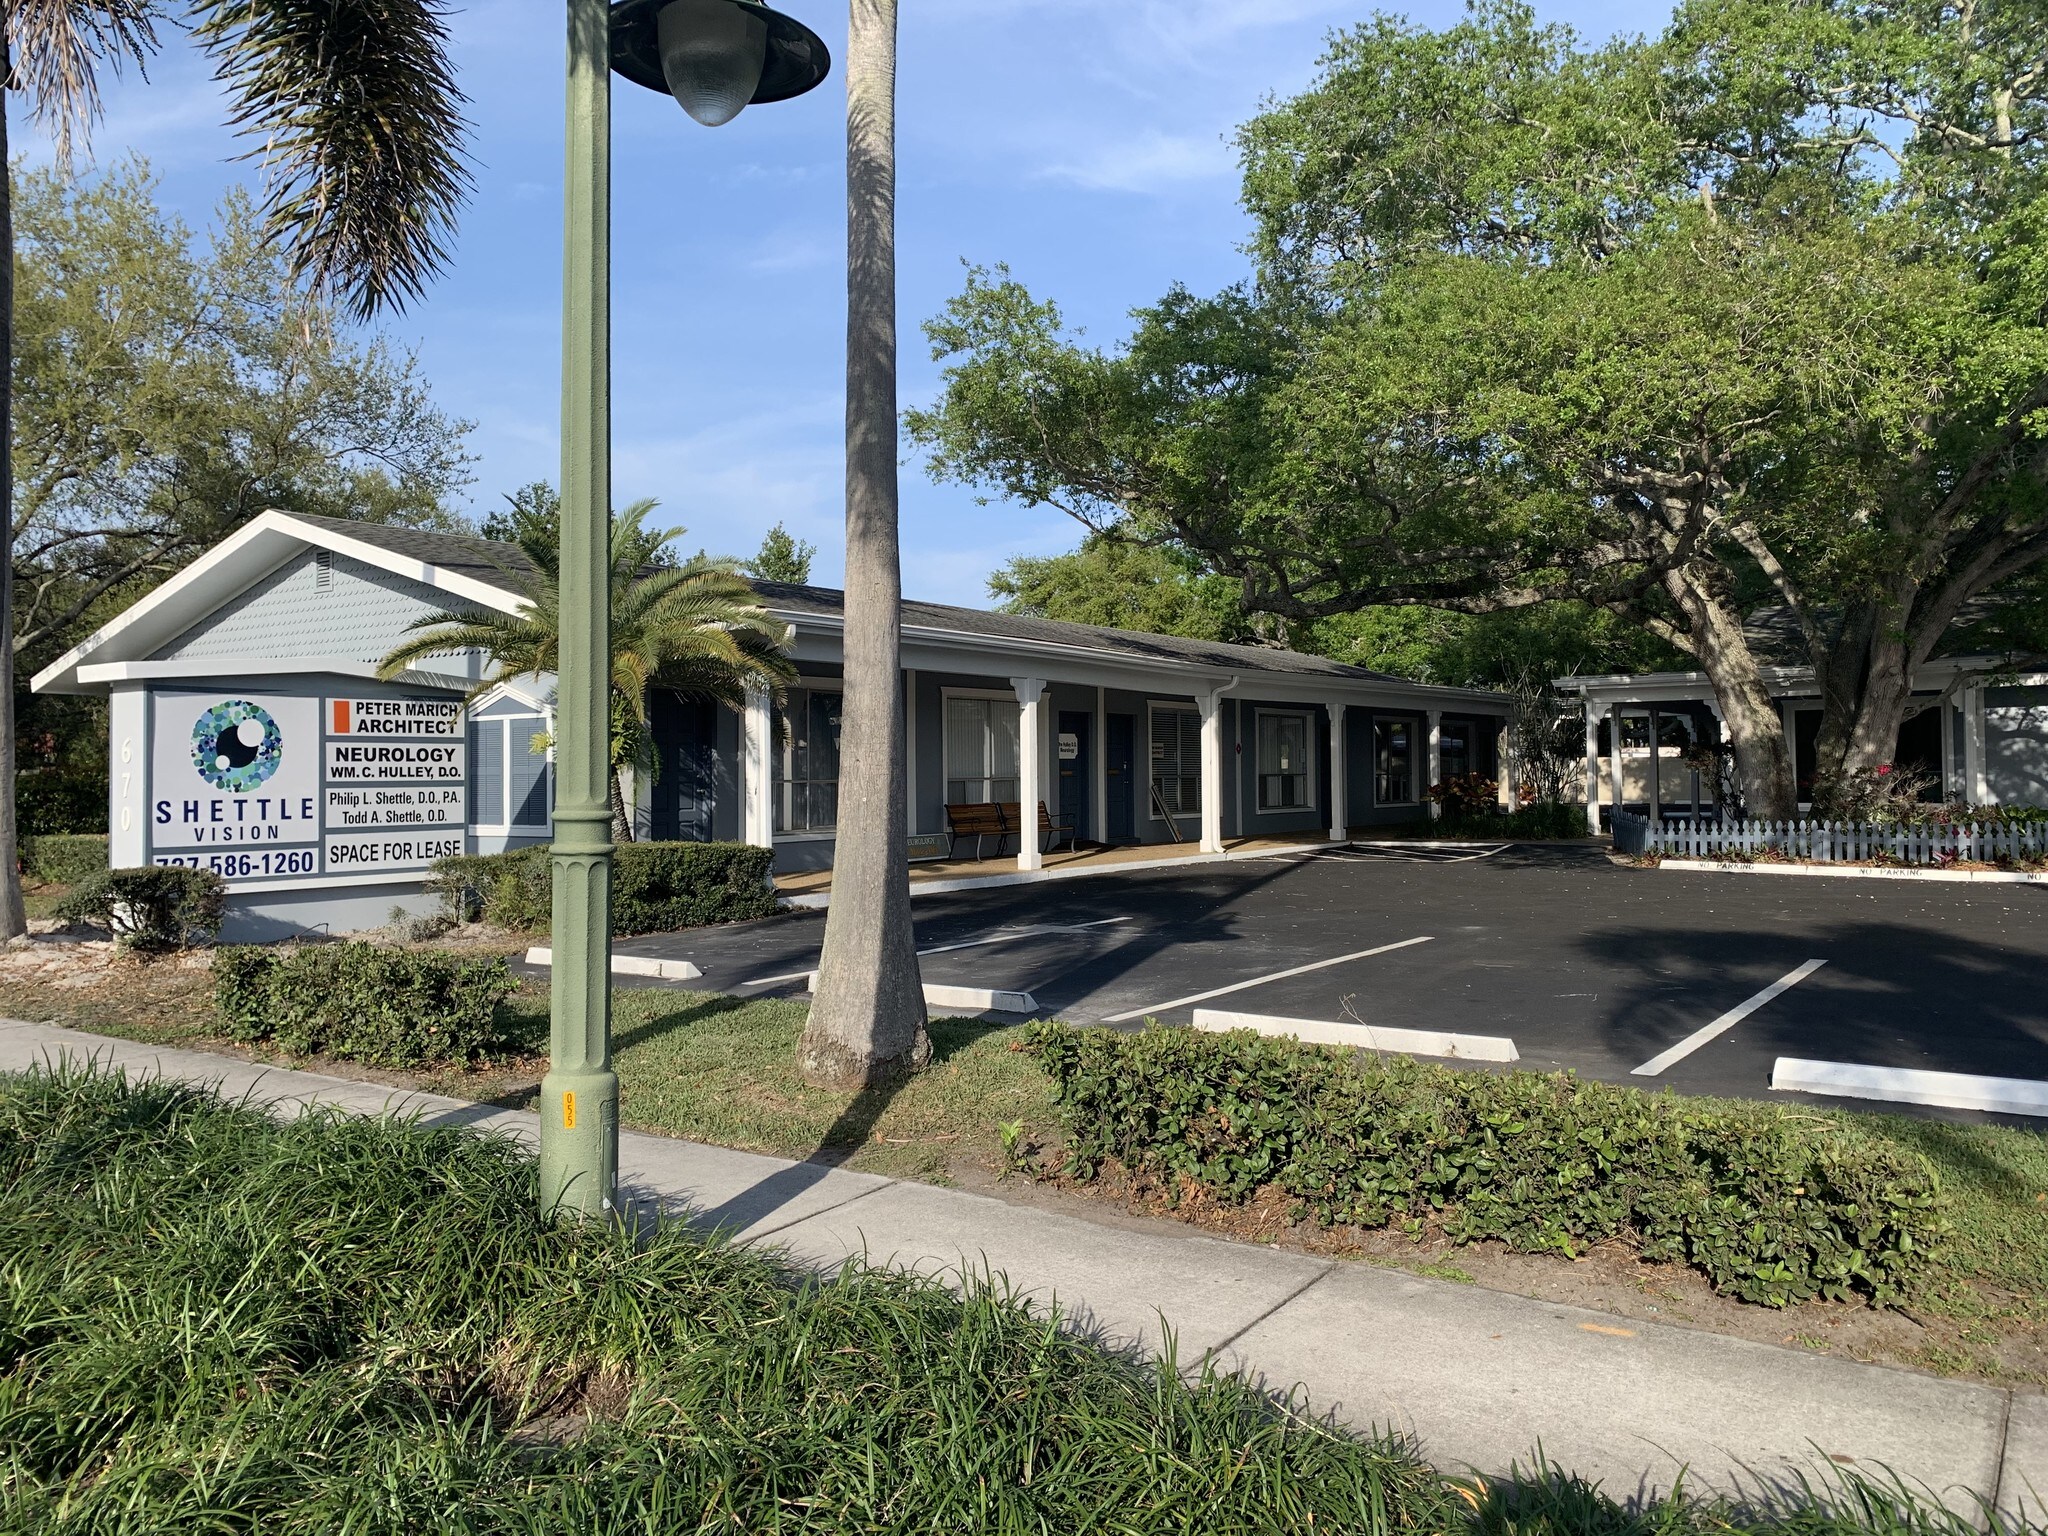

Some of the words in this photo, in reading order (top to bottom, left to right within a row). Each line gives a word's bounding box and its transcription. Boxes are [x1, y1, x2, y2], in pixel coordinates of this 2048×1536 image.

[356, 702, 401, 716] PETER
[406, 703, 457, 717] MARICH
[357, 719, 457, 734] ARCHITECT
[335, 747, 456, 762] NEUROLOGY
[331, 767, 360, 778] WM.
[362, 767, 375, 778] C.
[378, 767, 434, 780] HULLEY,
[438, 767, 461, 777] D.O.
[121, 736, 132, 832] 670
[330, 792, 360, 808] Philip
[363, 792, 372, 805] L.
[375, 791, 415, 805] Shettle,
[443, 791, 461, 804] P.A.
[156, 798, 313, 824] SHETTLE
[342, 811, 368, 824] Todd
[370, 811, 382, 824] A.
[386, 810, 425, 824] Shettle,
[428, 809, 447, 822] O.D.
[194, 825, 279, 842] VISION
[330, 845, 379, 864] SPACE
[383, 842, 413, 861] FOR
[417, 840, 461, 859] LEASE
[1716, 862, 1755, 871] PARKING
[1859, 868, 1873, 876] NO
[1880, 868, 1923, 877] PARKING
[2027, 873, 2042, 881] NO
